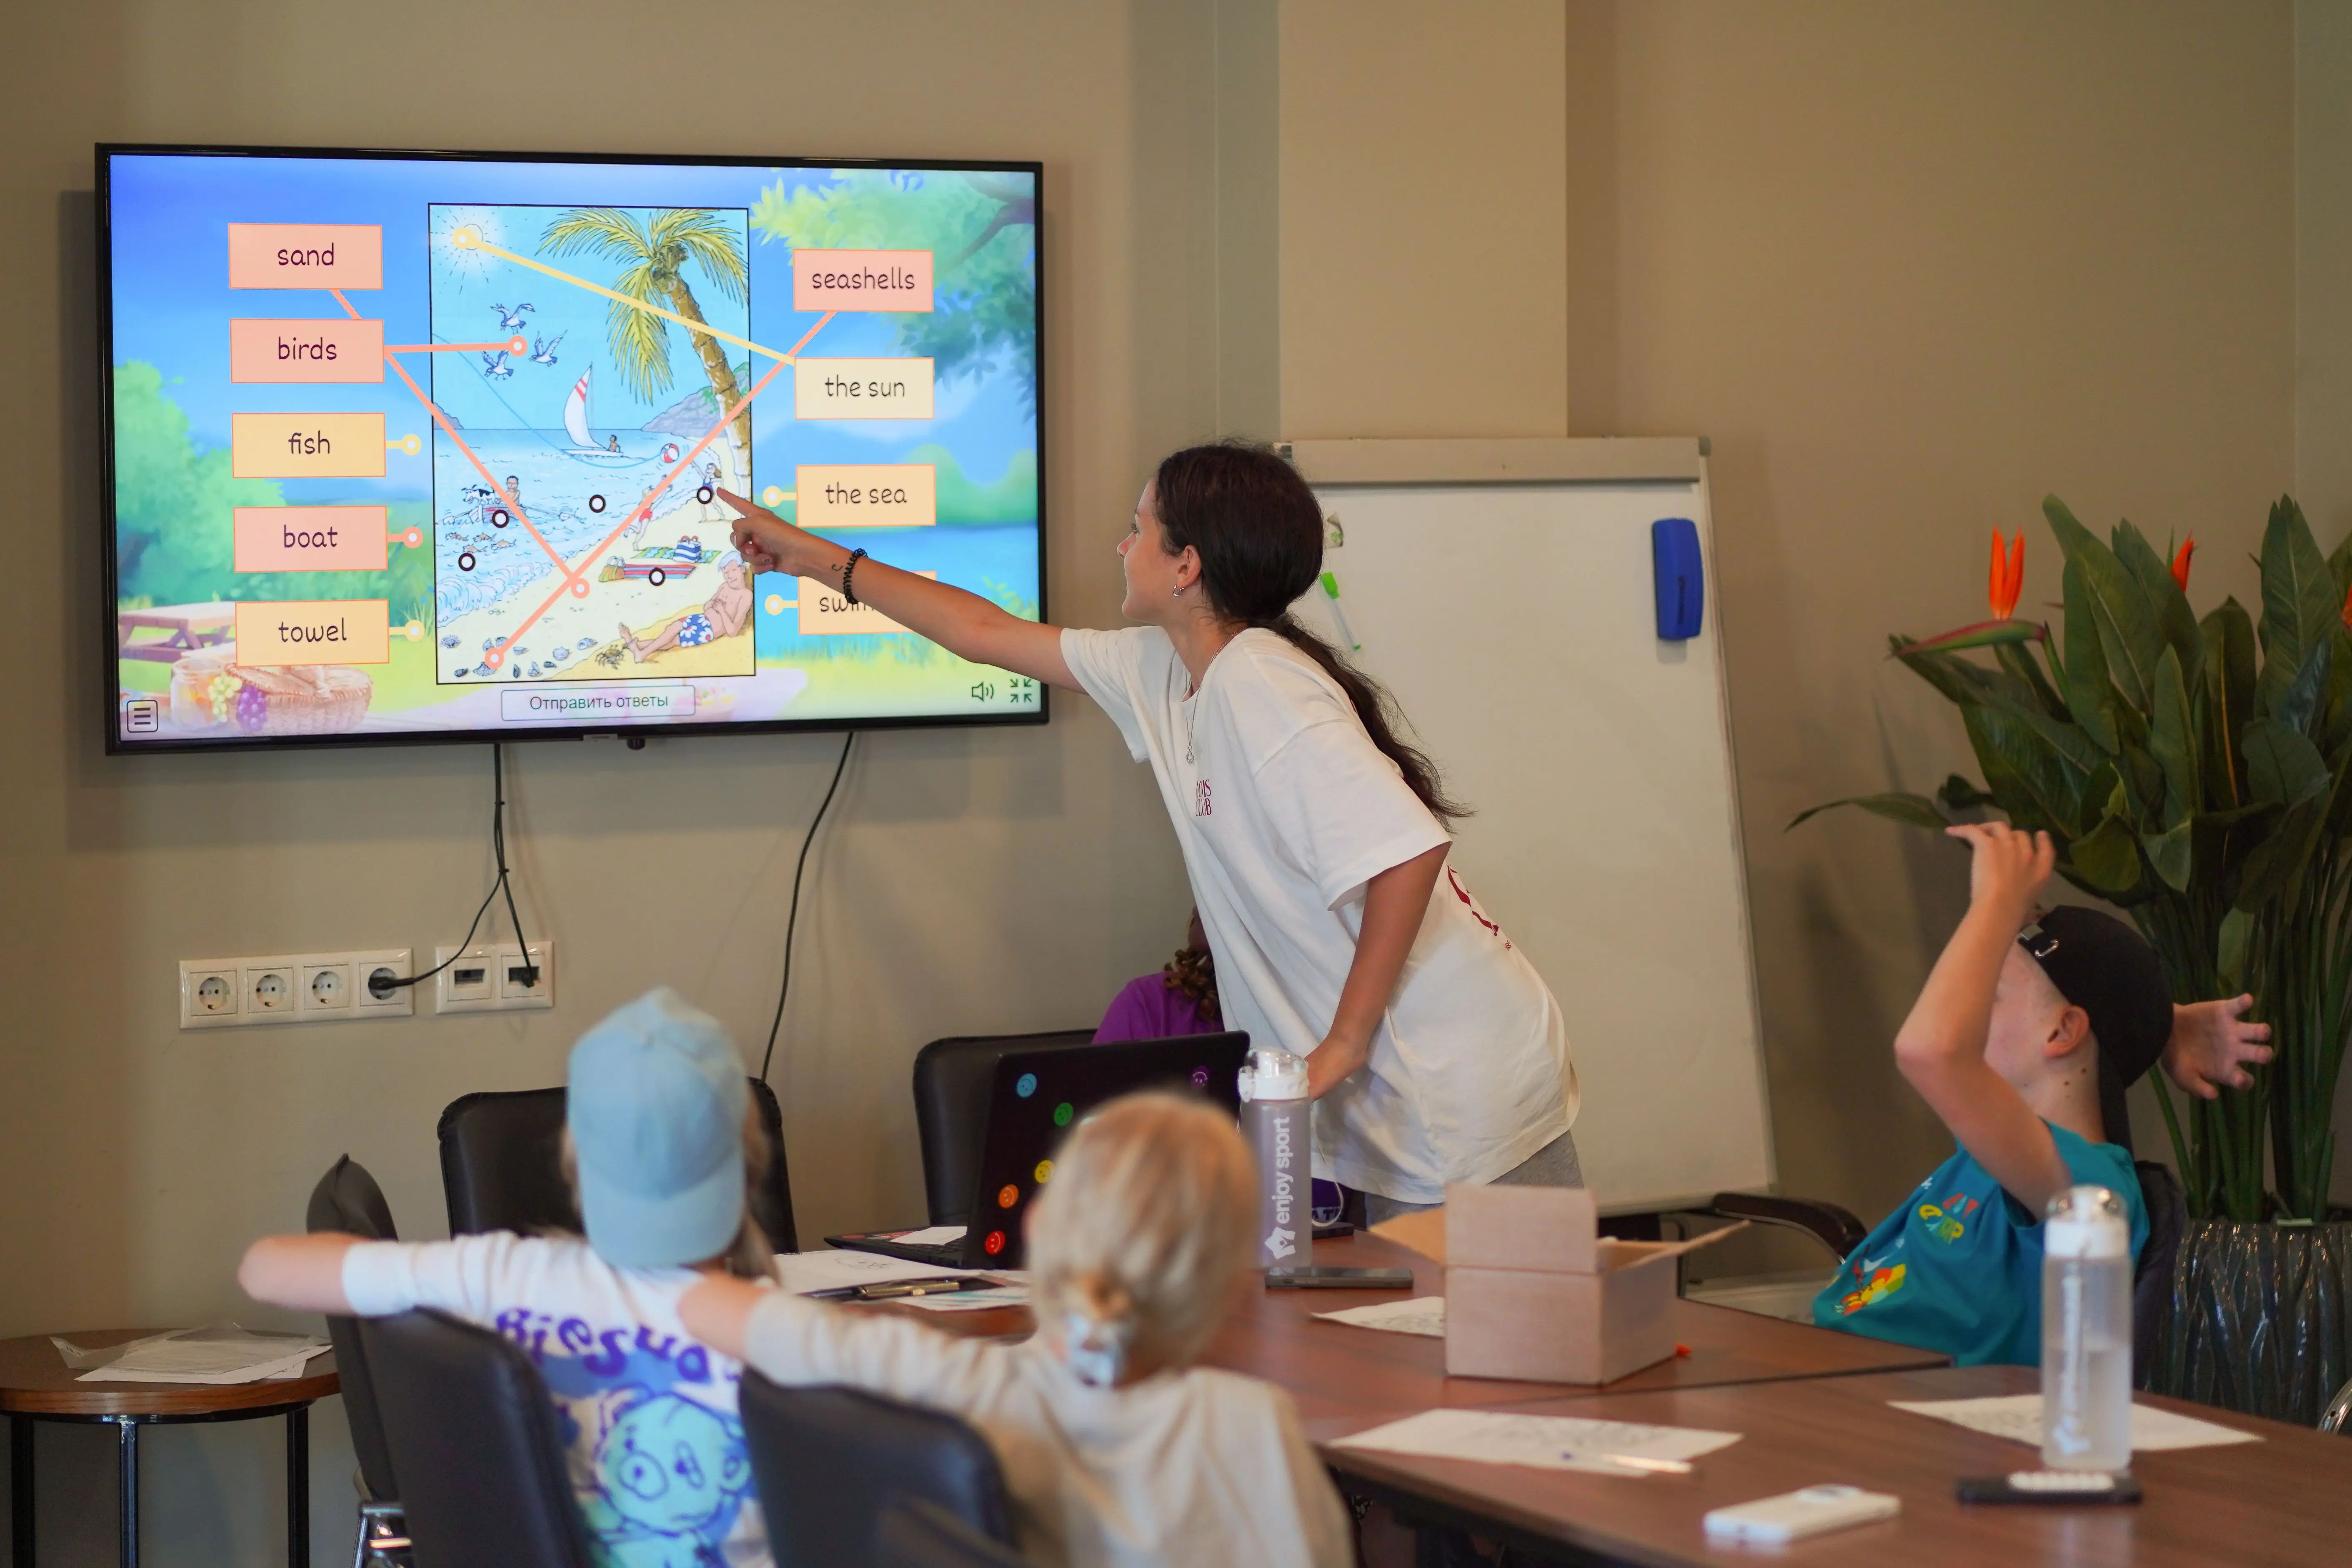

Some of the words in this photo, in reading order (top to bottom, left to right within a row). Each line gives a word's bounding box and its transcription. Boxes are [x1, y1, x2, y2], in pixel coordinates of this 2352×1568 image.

[277, 242, 335, 266] sand
[812, 267, 915, 290] seashells
[278, 336, 337, 360] birds
[825, 375, 861, 397] the
[869, 381, 905, 397] sun
[288, 430, 330, 454] fish
[825, 482, 861, 504] the
[869, 488, 907, 504] sea
[283, 524, 338, 548] boat
[278, 617, 347, 642] towel
[530, 696, 612, 713] Отправить
[616, 695, 668, 708] ответы
[1195, 798, 1212, 816] CLUB
[1274, 1116, 1294, 1168] sport
[1271, 1171, 1294, 1224] enjoy
